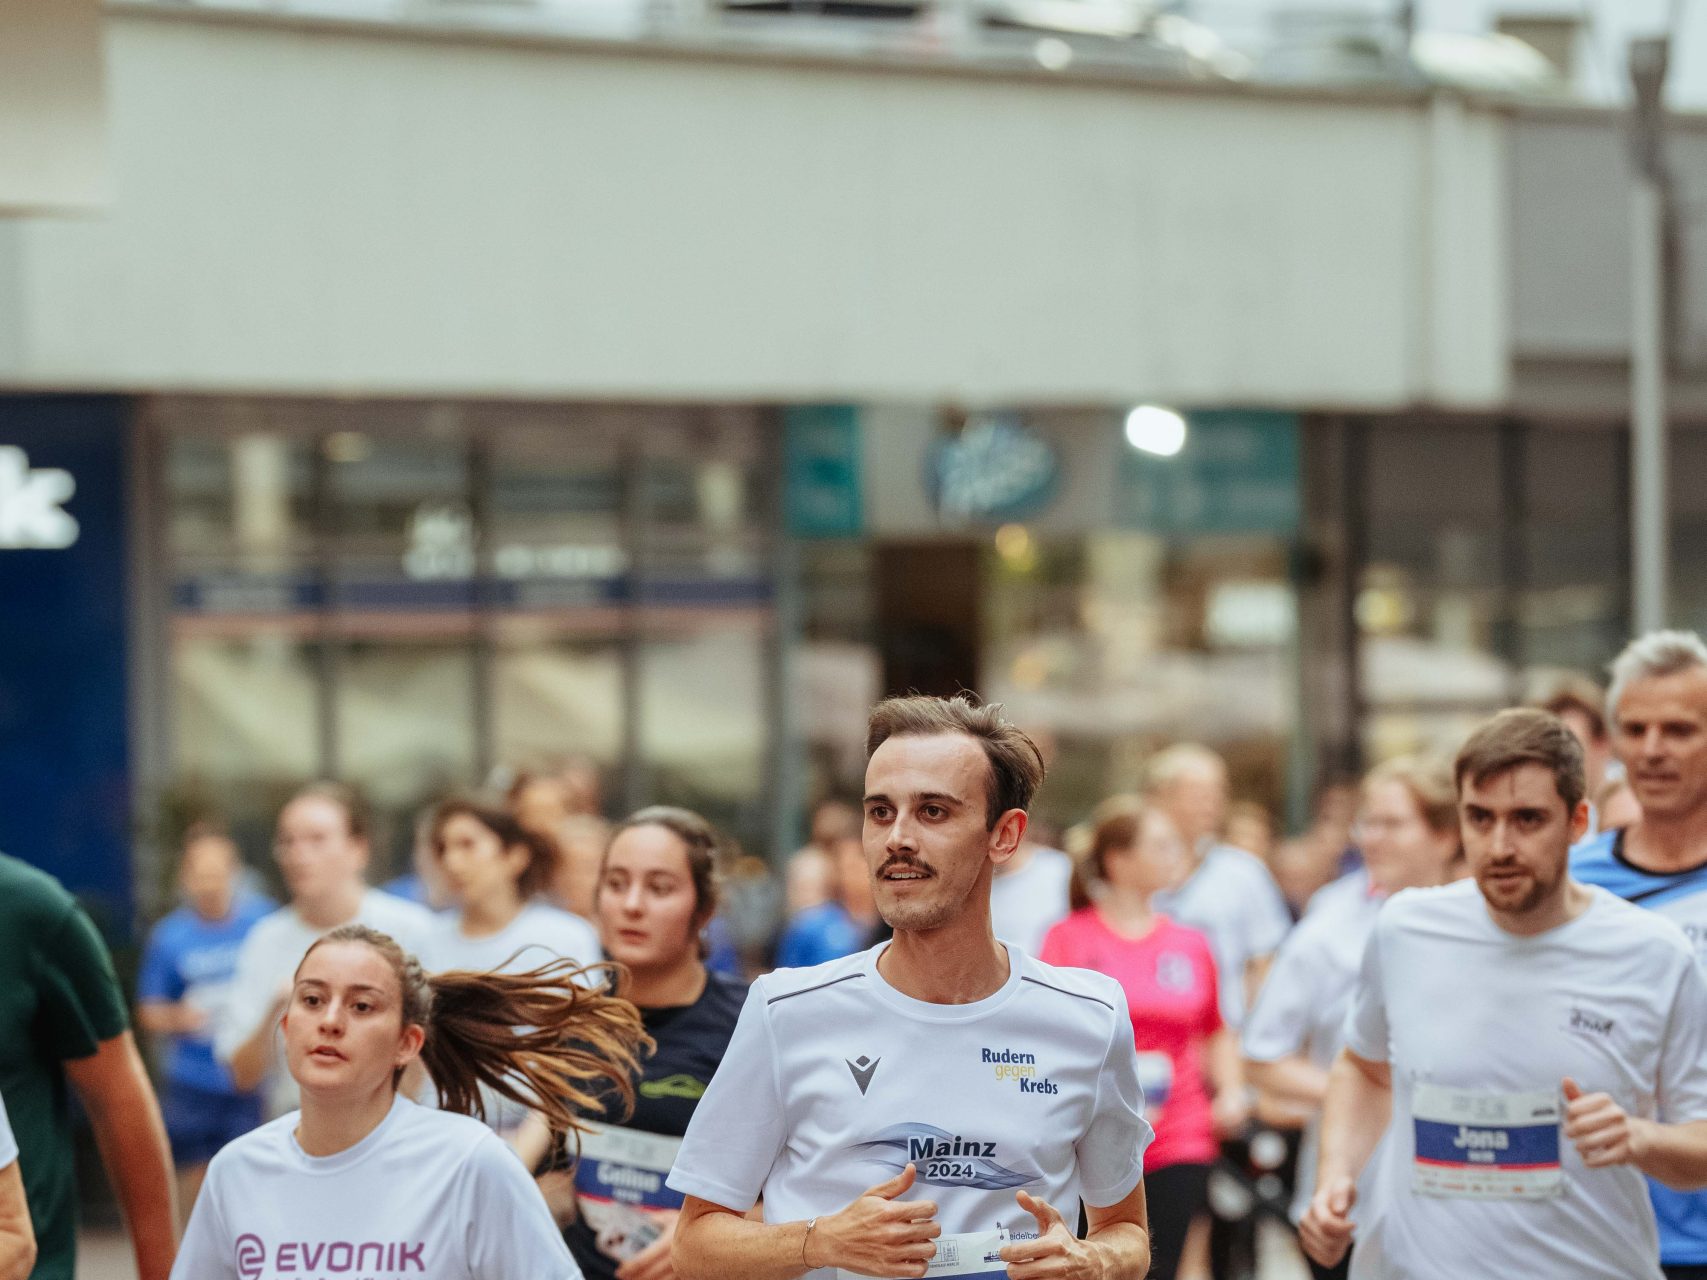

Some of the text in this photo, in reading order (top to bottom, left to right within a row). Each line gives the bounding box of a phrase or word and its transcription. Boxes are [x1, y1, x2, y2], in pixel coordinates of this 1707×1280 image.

[982, 1048, 1035, 1064] Rudern
[995, 1064, 1035, 1081] gegen
[1020, 1077, 1058, 1095] Krebs
[910, 1136, 996, 1161] Mainz
[928, 1163, 974, 1178] 2024
[276, 1241, 425, 1272] EVONIK
